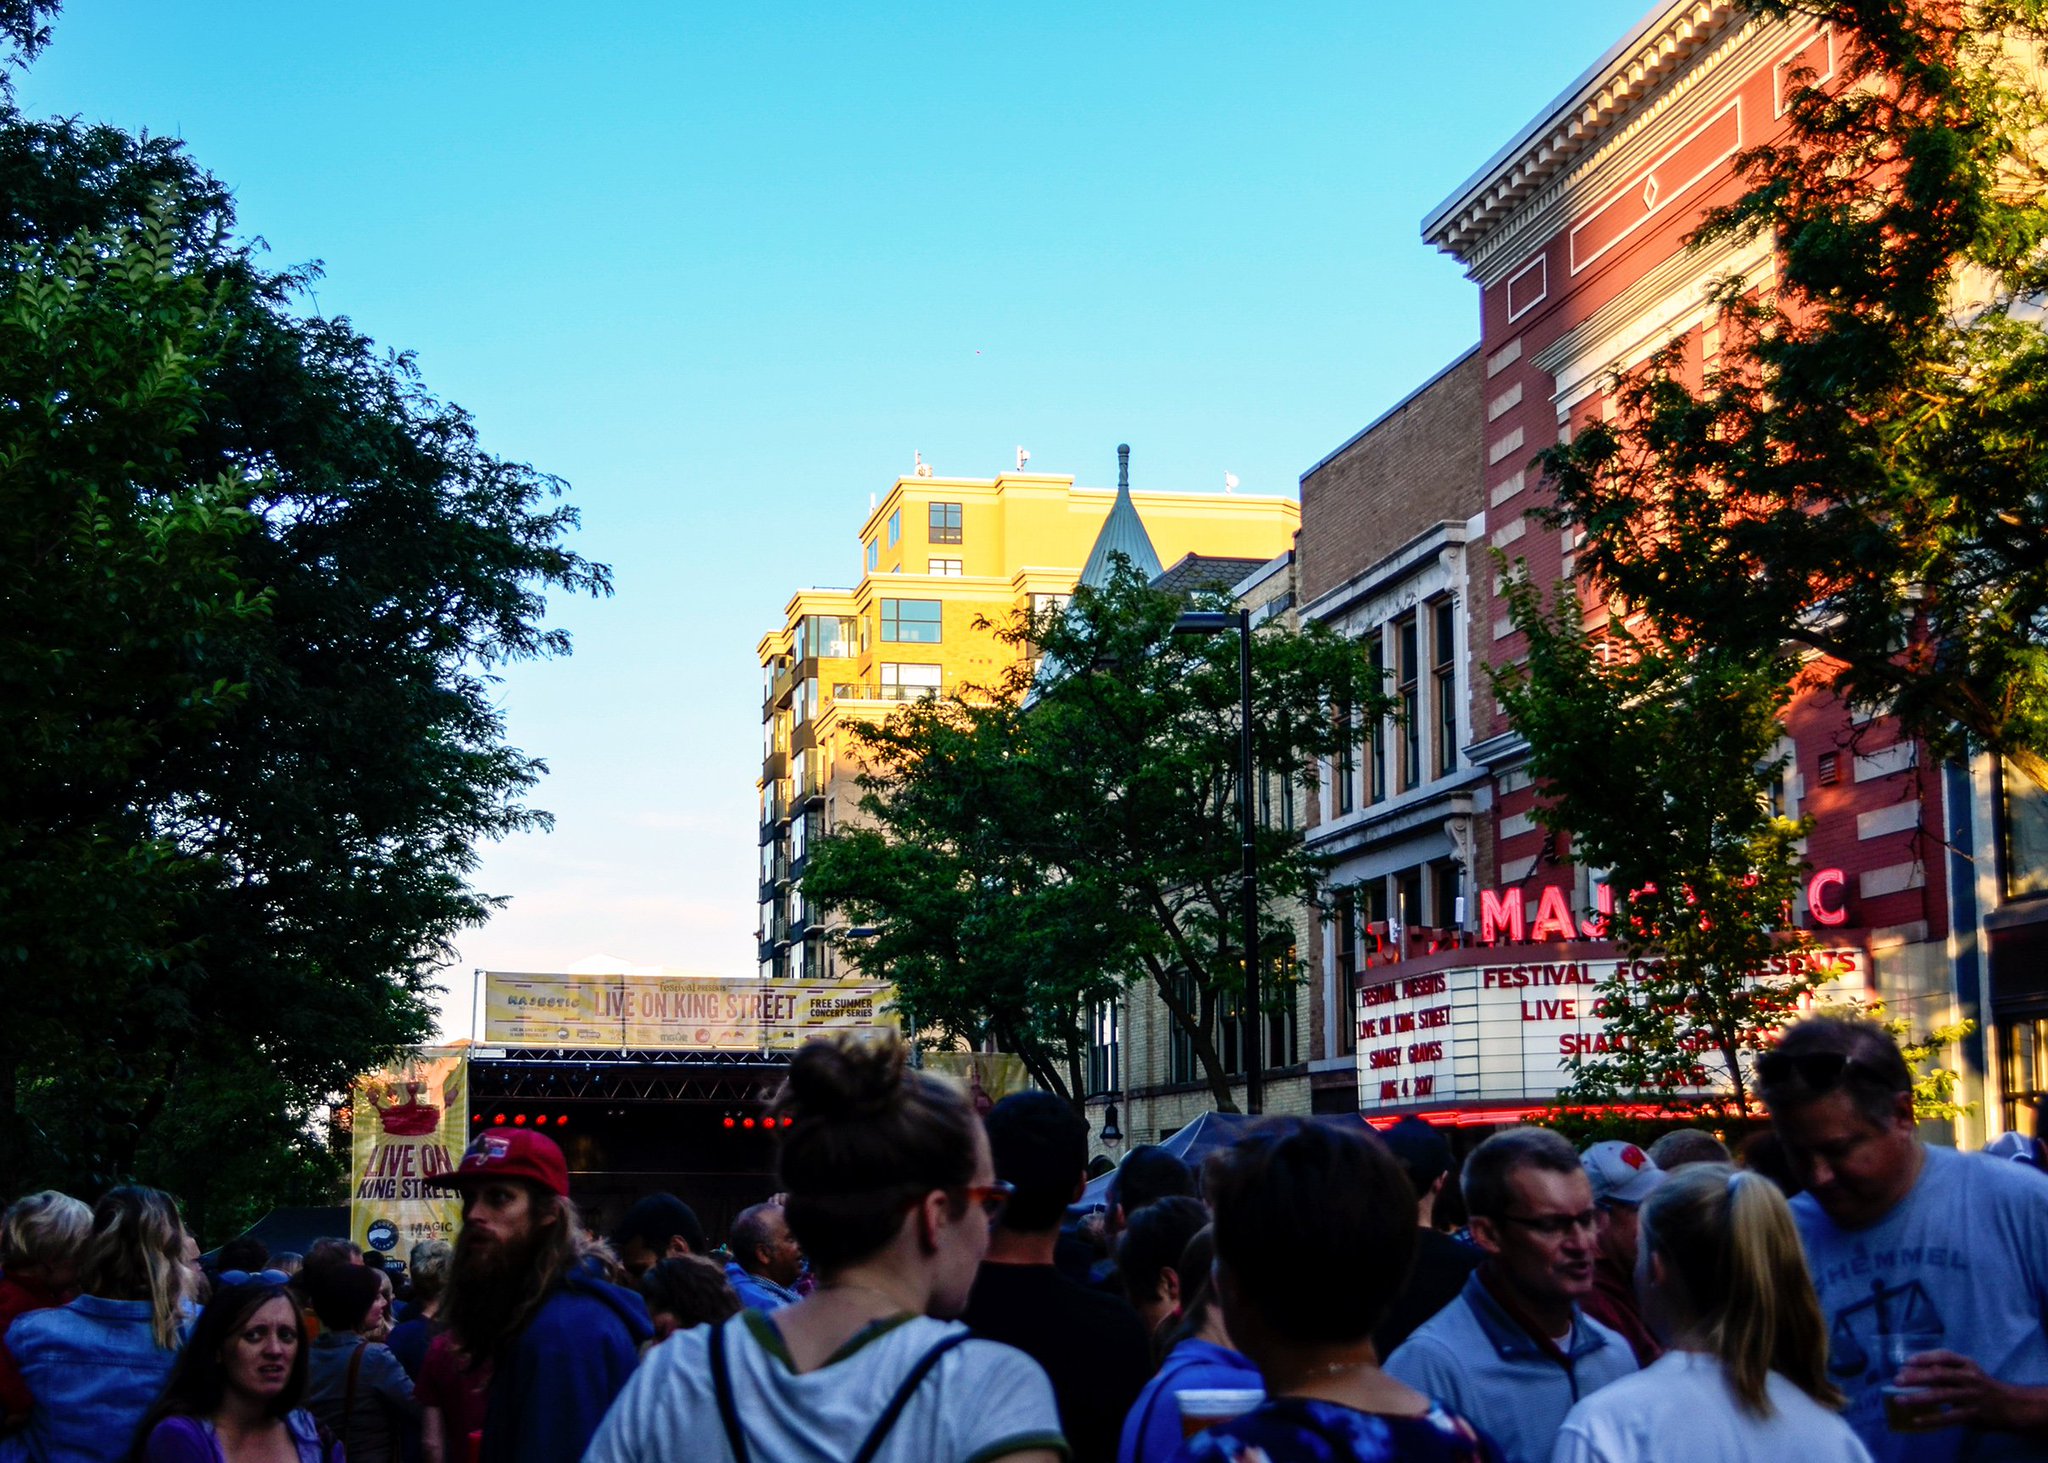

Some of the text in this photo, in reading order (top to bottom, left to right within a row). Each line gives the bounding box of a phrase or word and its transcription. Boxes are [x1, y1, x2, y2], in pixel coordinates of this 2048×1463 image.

[1480, 868, 1845, 943] MAJC
[1484, 963, 1596, 989] FESTIVAL
[1362, 972, 1446, 1007] FESTIVAL PRESENTS
[594, 991, 797, 1020] LIVE ON KING STREET
[810, 999, 873, 1008] FREE SUMMER
[810, 1008, 873, 1017] CONCERT SERIES
[1521, 999, 1576, 1021] LIVE
[1359, 1004, 1451, 1039] LIVE ON KING STREET
[1408, 1041, 1443, 1064] GRAVES
[1402, 1078, 1408, 1097] 4
[364, 1144, 453, 1177] LIVE ON
[357, 1179, 396, 1199] KING
[410, 1221, 453, 1236] MAGIC
